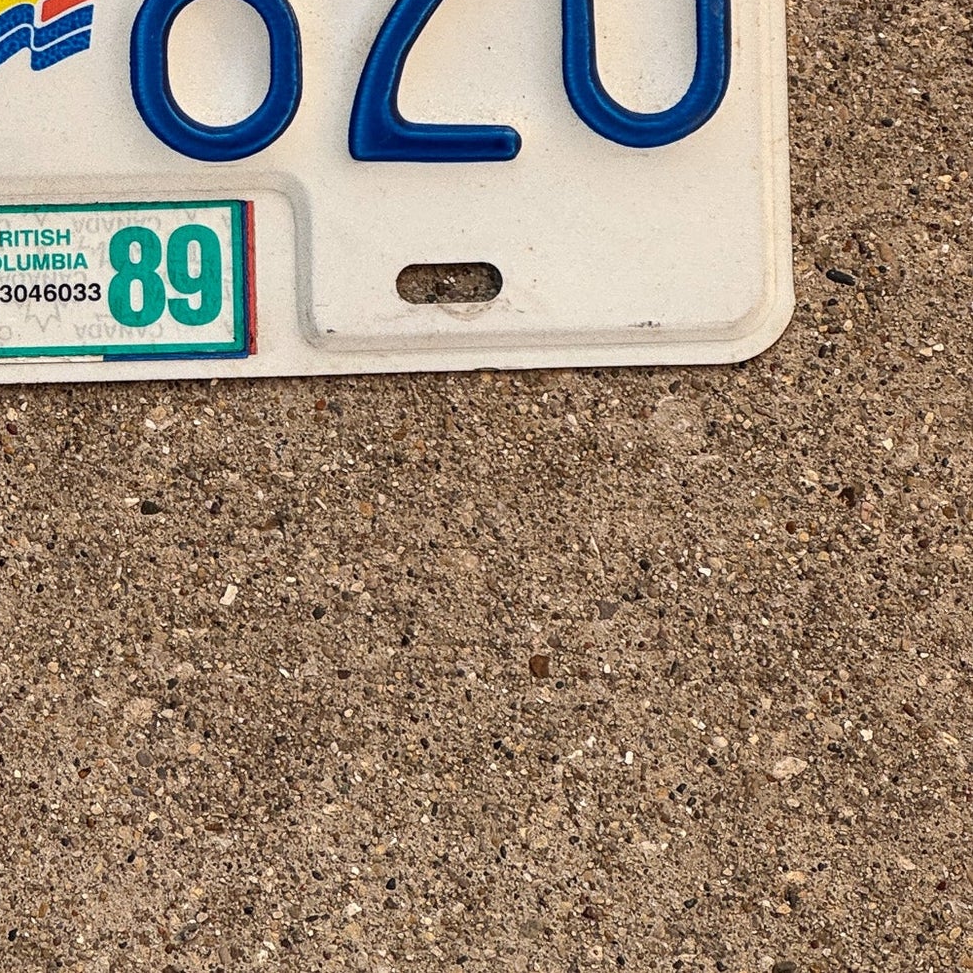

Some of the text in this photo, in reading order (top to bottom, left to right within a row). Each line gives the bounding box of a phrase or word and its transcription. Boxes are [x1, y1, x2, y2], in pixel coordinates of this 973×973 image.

[73, 216, 161, 233] CANADA
[108, 224, 222, 327] 89
[76, 321, 163, 339] CANADA
